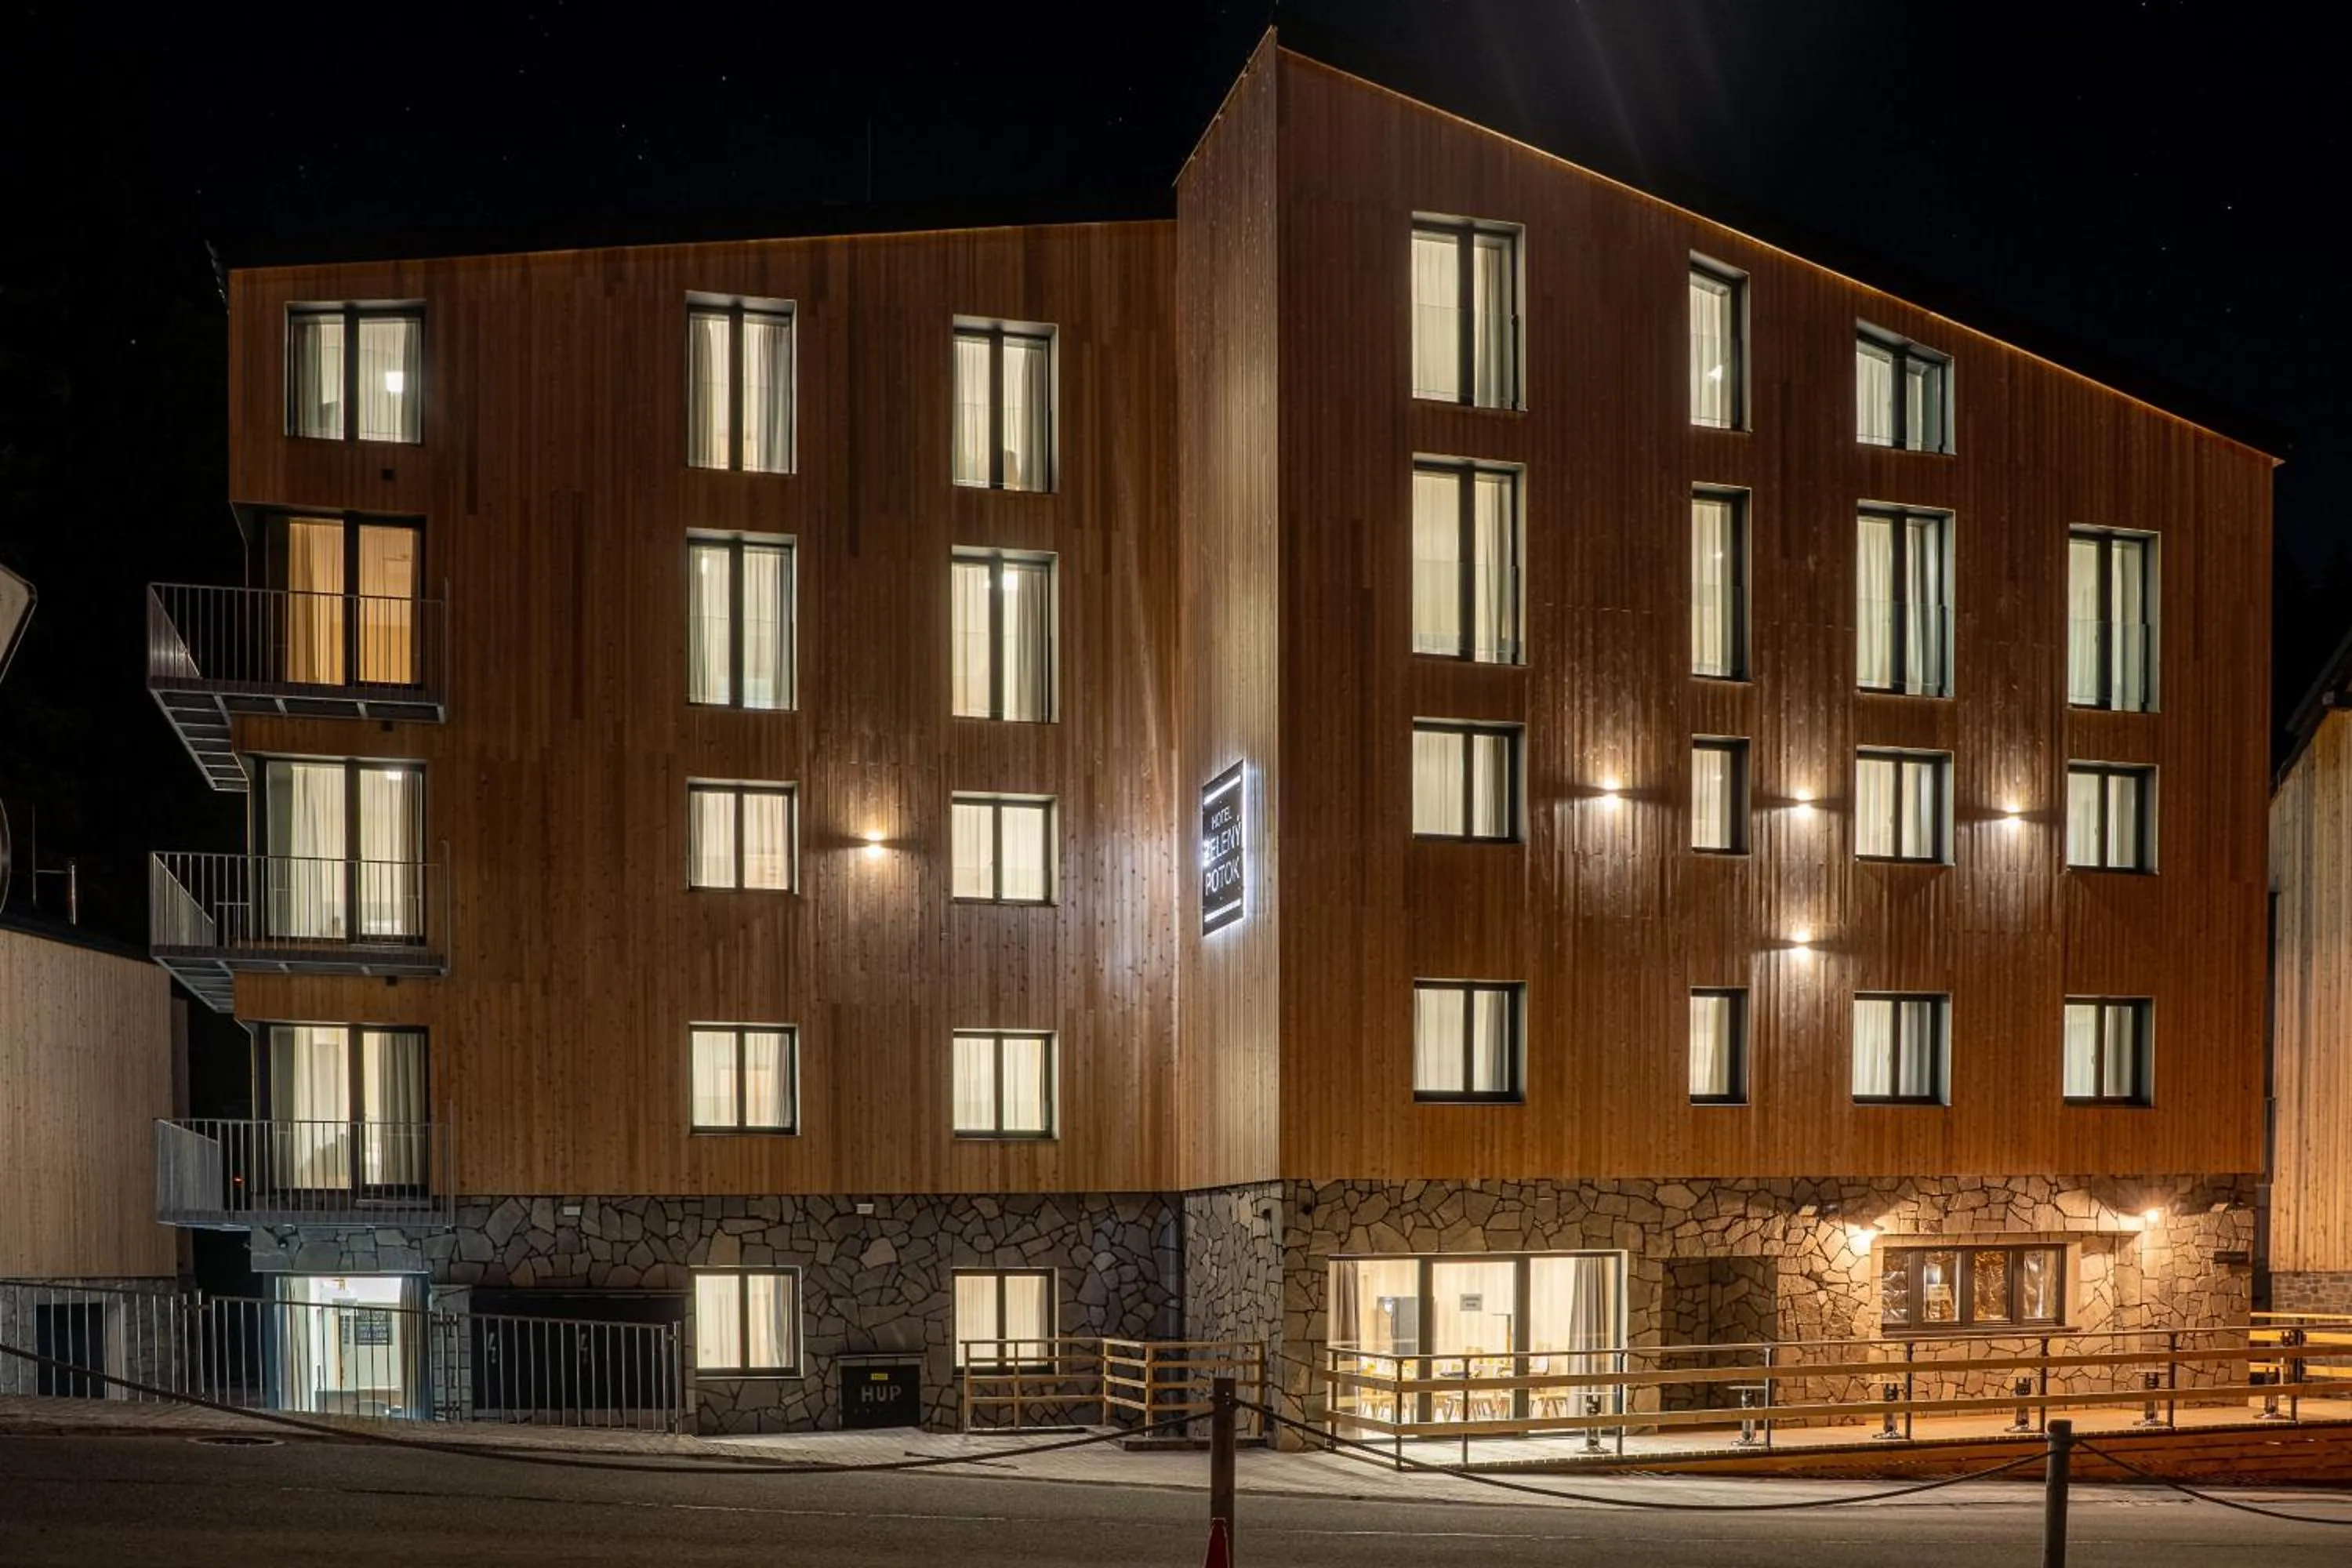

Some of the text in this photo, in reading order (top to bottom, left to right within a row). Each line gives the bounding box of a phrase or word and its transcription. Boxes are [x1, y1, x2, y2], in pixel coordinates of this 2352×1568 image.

[1211, 806, 1232, 830] HOTEL
[1205, 856, 1240, 896] POTOK
[862, 1385, 902, 1403] HUP
